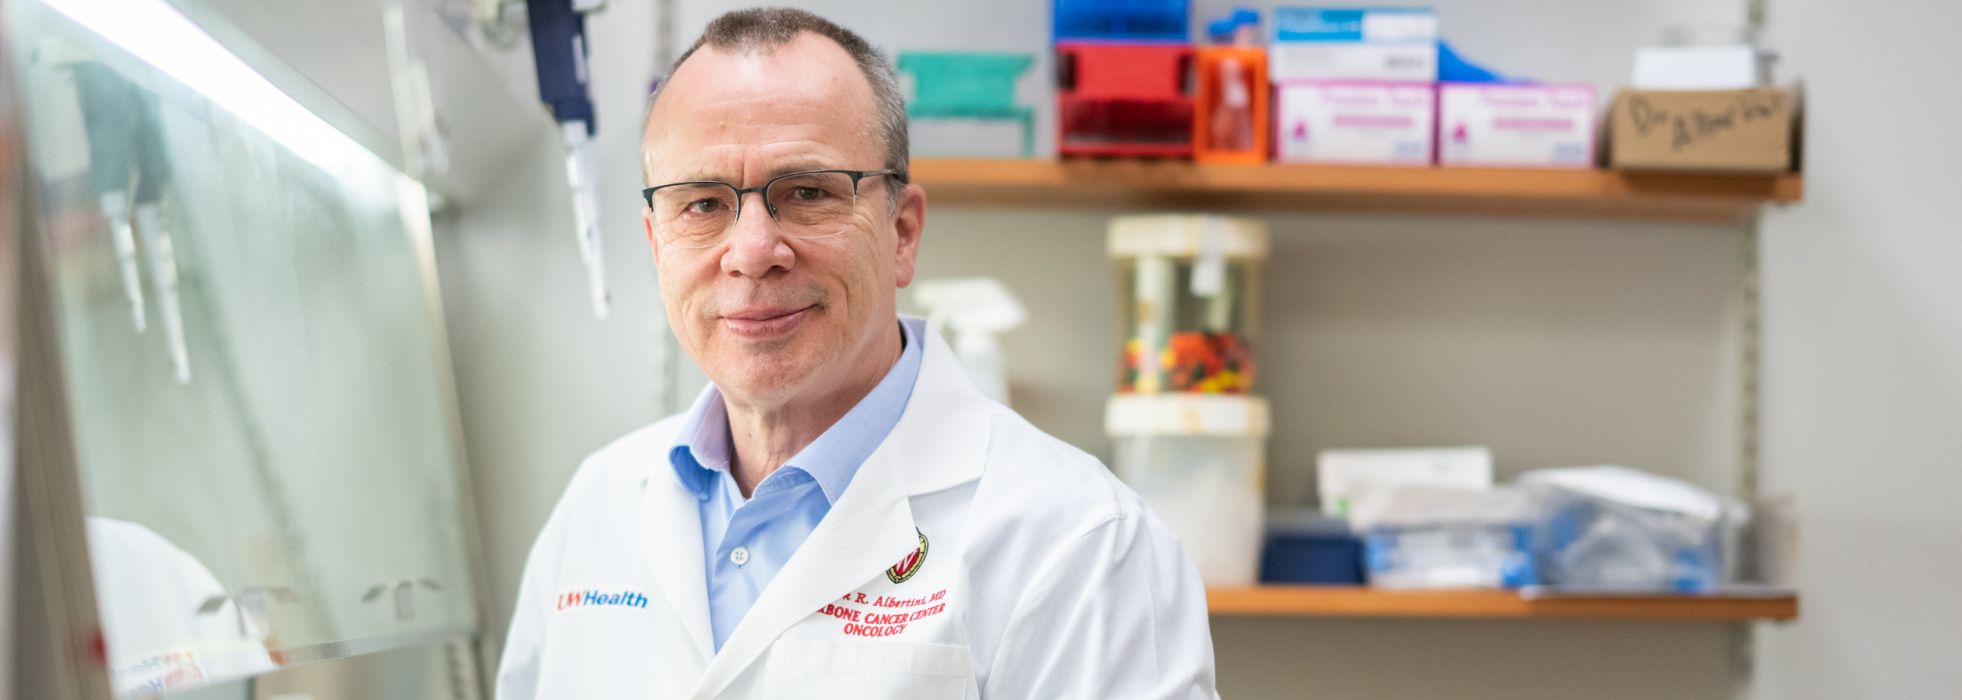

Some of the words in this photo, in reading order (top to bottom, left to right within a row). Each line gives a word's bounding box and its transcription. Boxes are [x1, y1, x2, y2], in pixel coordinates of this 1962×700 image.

[928, 589, 947, 603] MD
[864, 612, 909, 625] CANCER
[909, 602, 946, 621] CENTER
[843, 623, 907, 637] ONCOLOGY
